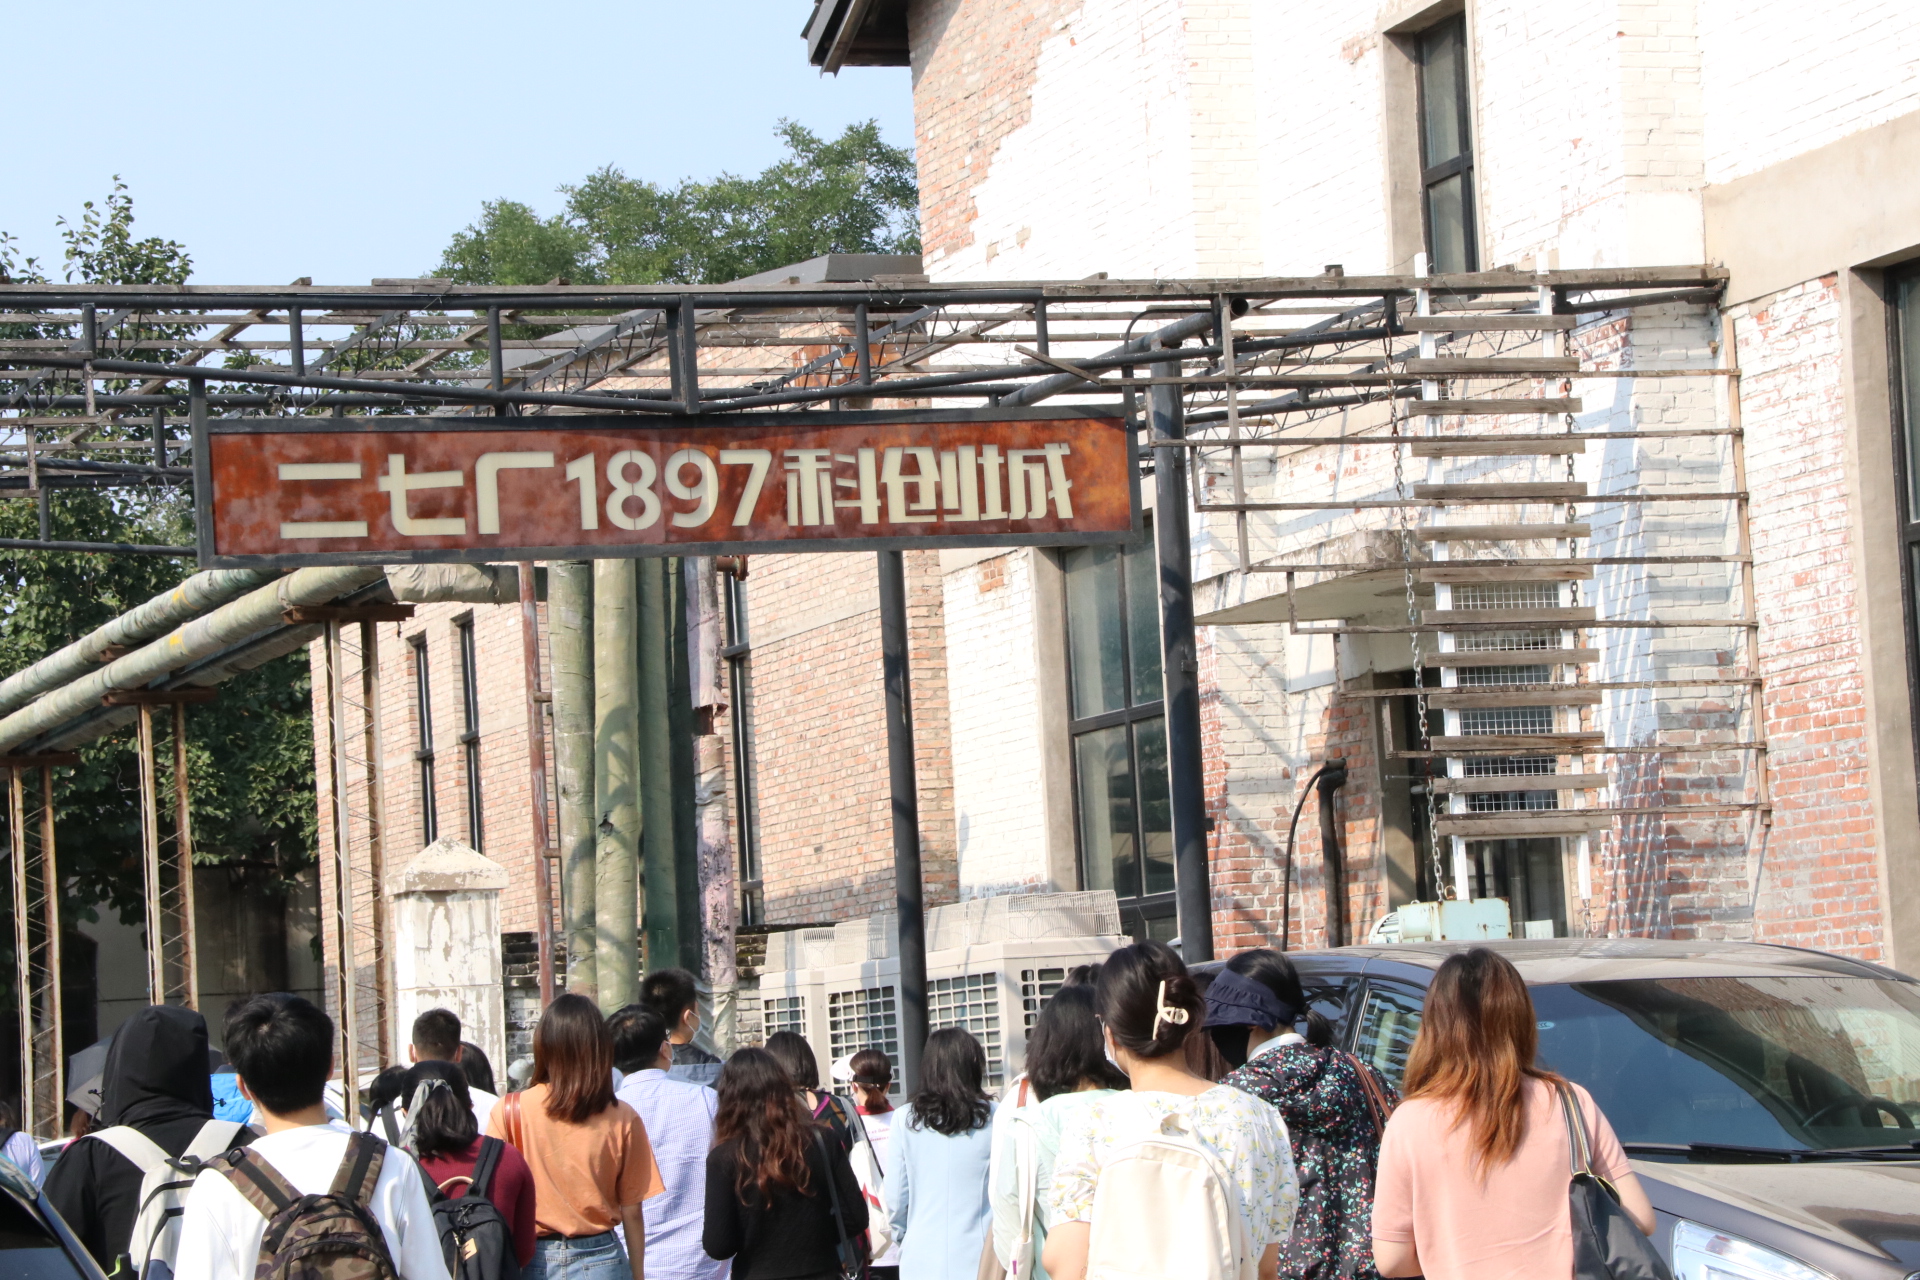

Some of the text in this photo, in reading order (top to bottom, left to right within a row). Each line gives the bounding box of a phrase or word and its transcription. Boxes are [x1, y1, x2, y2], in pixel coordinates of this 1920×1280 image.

[279, 445, 1073, 538] 二七厂1897科创城
